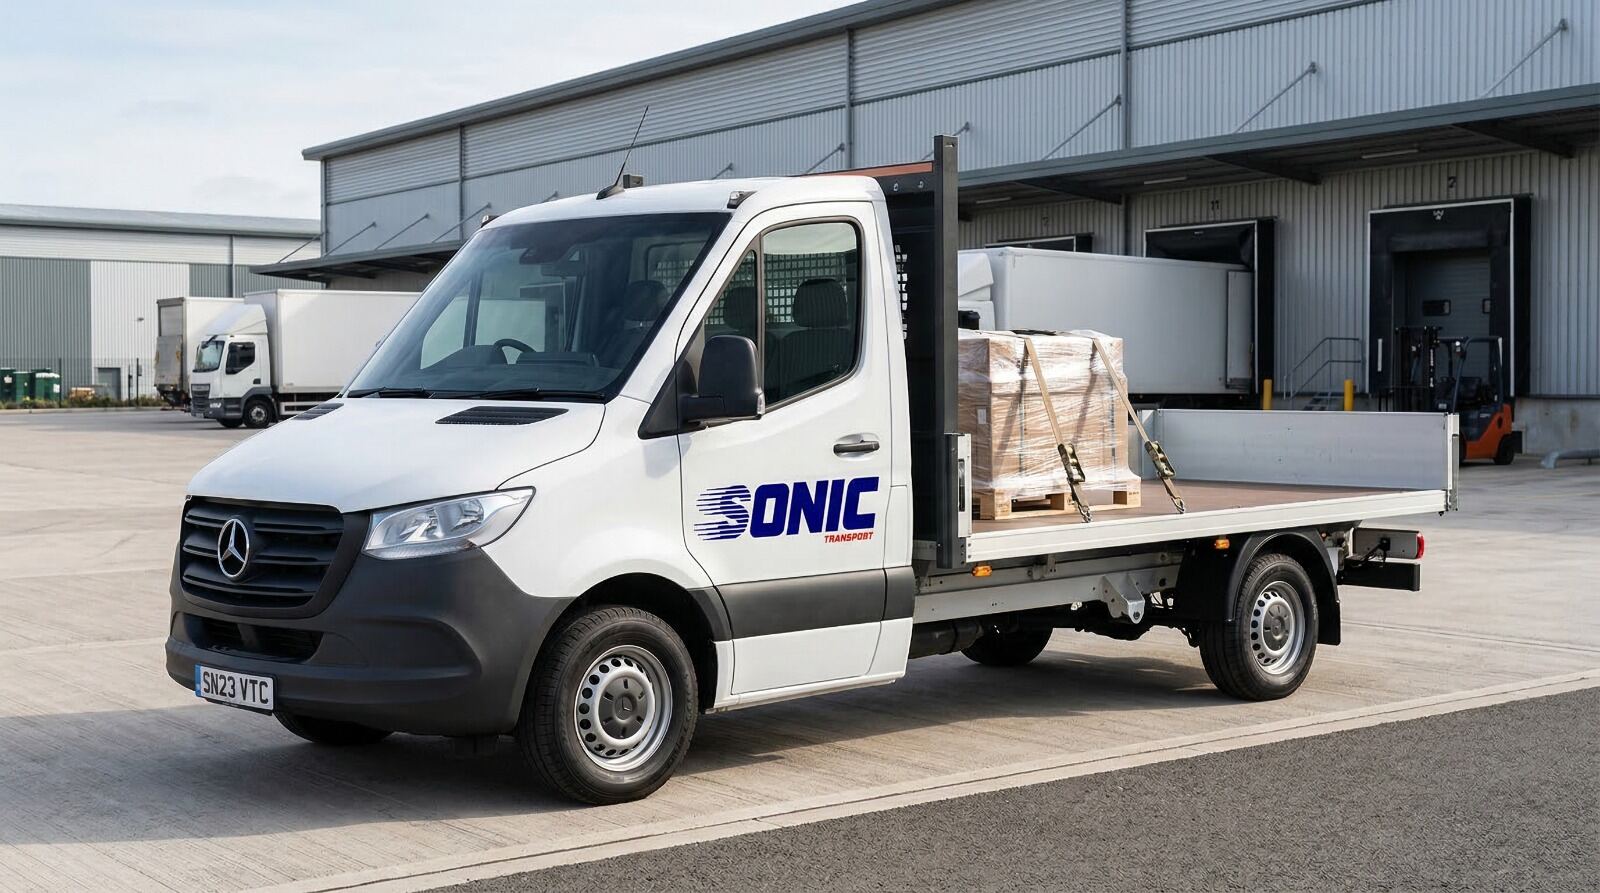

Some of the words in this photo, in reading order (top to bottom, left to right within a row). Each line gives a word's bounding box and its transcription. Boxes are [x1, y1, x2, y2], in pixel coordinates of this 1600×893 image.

[694, 476, 880, 541] SONIC
[203, 671, 236, 698] SN23
[240, 677, 269, 704] VTC
